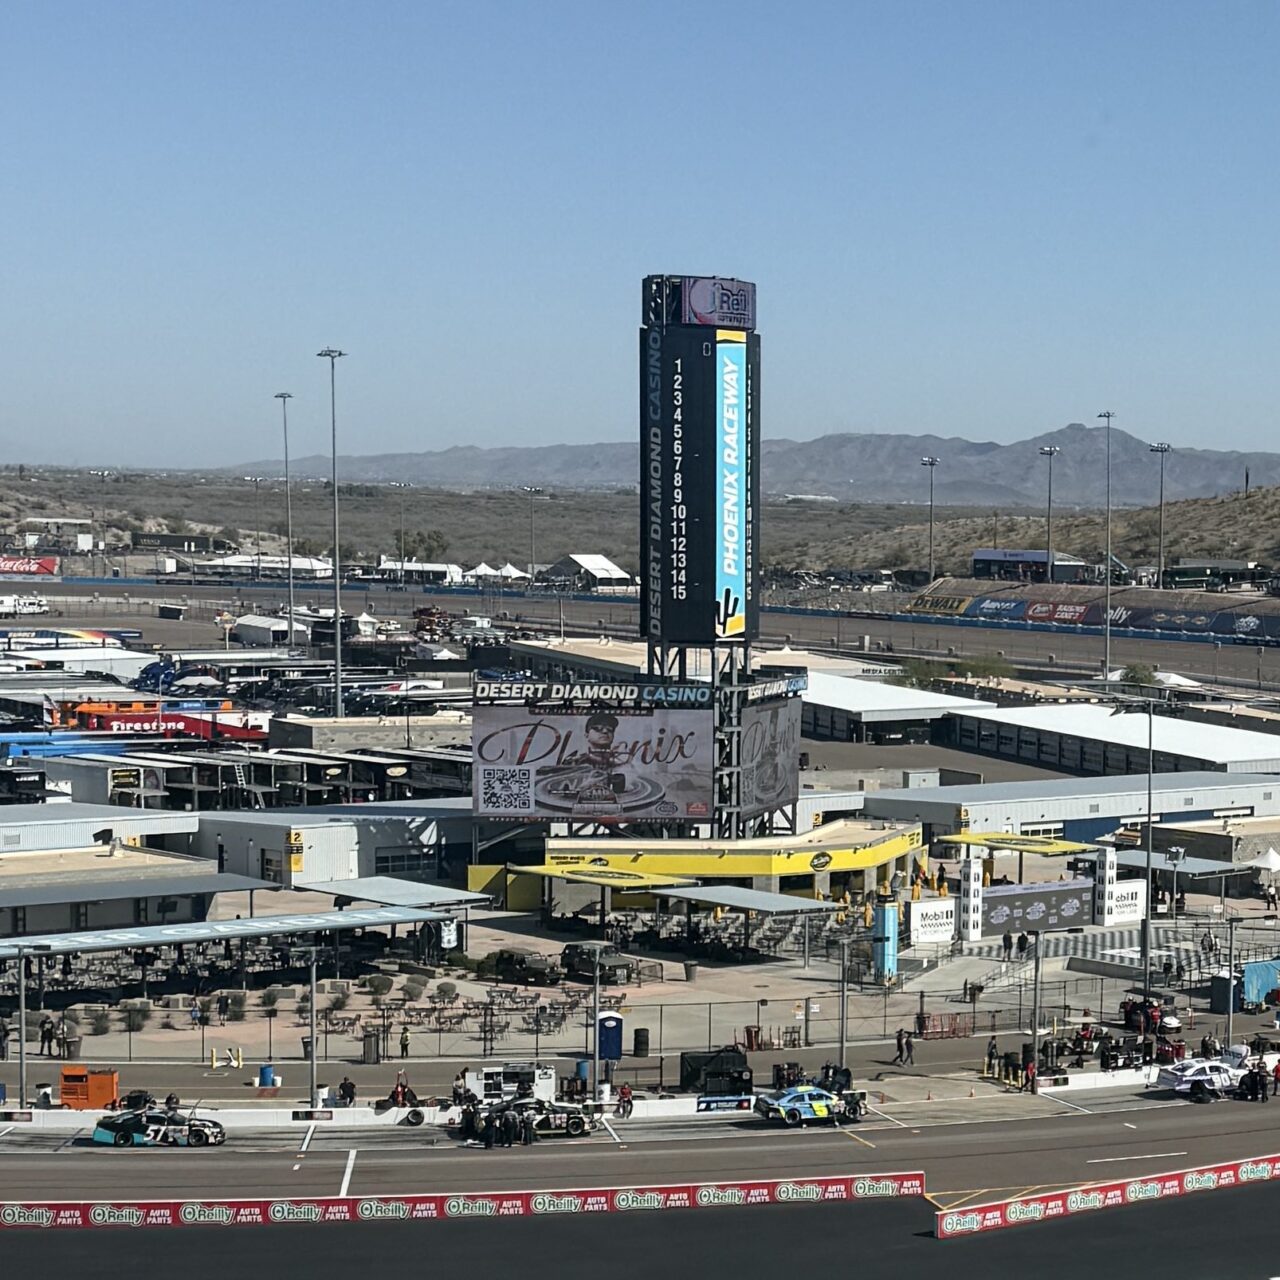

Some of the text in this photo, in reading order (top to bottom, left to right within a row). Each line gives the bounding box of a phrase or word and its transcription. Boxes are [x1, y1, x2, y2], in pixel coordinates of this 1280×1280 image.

[674, 358, 682, 372] 1
[673, 375, 682, 389] 2
[673, 391, 682, 405] 3
[673, 408, 682, 421] 4
[673, 424, 682, 438] 5
[673, 441, 682, 454] 6
[674, 457, 682, 470] 7
[723, 355, 739, 576] PHOENIX RACEWAY
[649, 333, 662, 636] DESERT DIAMOND CASINO
[673, 473, 682, 486] 8
[673, 489, 682, 502] 9
[671, 505, 686, 519] 10
[671, 522, 686, 535] 11
[671, 538, 686, 551] 12
[671, 554, 686, 567] 13
[671, 570, 686, 583] 14
[671, 586, 686, 599] 15
[476, 683, 711, 702] DESERT DIAMOND CASINO
[110, 719, 185, 731] Firestone
[1239, 1163, 1272, 1181] O'Reilly
[902, 1181, 921, 1189] AUTO
[1184, 1173, 1218, 1191] O'Reilly
[777, 1184, 823, 1203] O'Reilly
[826, 1185, 846, 1193] AUTO
[853, 1179, 899, 1199] O'Reilly
[900, 1187, 922, 1196] PARTS
[1127, 1182, 1161, 1201] O'Reilly
[586, 1197, 607, 1205] AUTO
[615, 1191, 664, 1211] O'Reilly
[667, 1193, 688, 1201] AUTO
[699, 1187, 745, 1207] O'Reilly
[746, 1195, 770, 1203] PARTS
[824, 1192, 847, 1200] PARTS
[1068, 1193, 1104, 1211] O'Reilly
[328, 1206, 350, 1214] AUTO
[361, 1200, 409, 1220] O'Reilly
[415, 1203, 437, 1211] AUTO
[447, 1197, 496, 1217] O'Reilly
[500, 1200, 522, 1208] AUTO
[533, 1195, 581, 1215] O'Reilly
[584, 1203, 608, 1212] PARTS
[666, 1200, 690, 1208] PARTS
[4, 1204, 54, 1225] O'Reilly
[59, 1210, 82, 1218] AUTO
[93, 1204, 143, 1225] O'Reilly
[149, 1209, 172, 1217] AUTO
[182, 1203, 234, 1224] O'Reilly
[239, 1208, 261, 1216] AUTO
[272, 1202, 322, 1222] O'Reilly
[412, 1210, 438, 1218] PARTS
[499, 1207, 524, 1216] PARTS
[1007, 1203, 1045, 1223] O'Reilly
[57, 1217, 83, 1225] PARTS
[147, 1216, 173, 1225] PARTS
[237, 1215, 263, 1223] PARTS
[944, 1213, 981, 1234] O'Reilly
